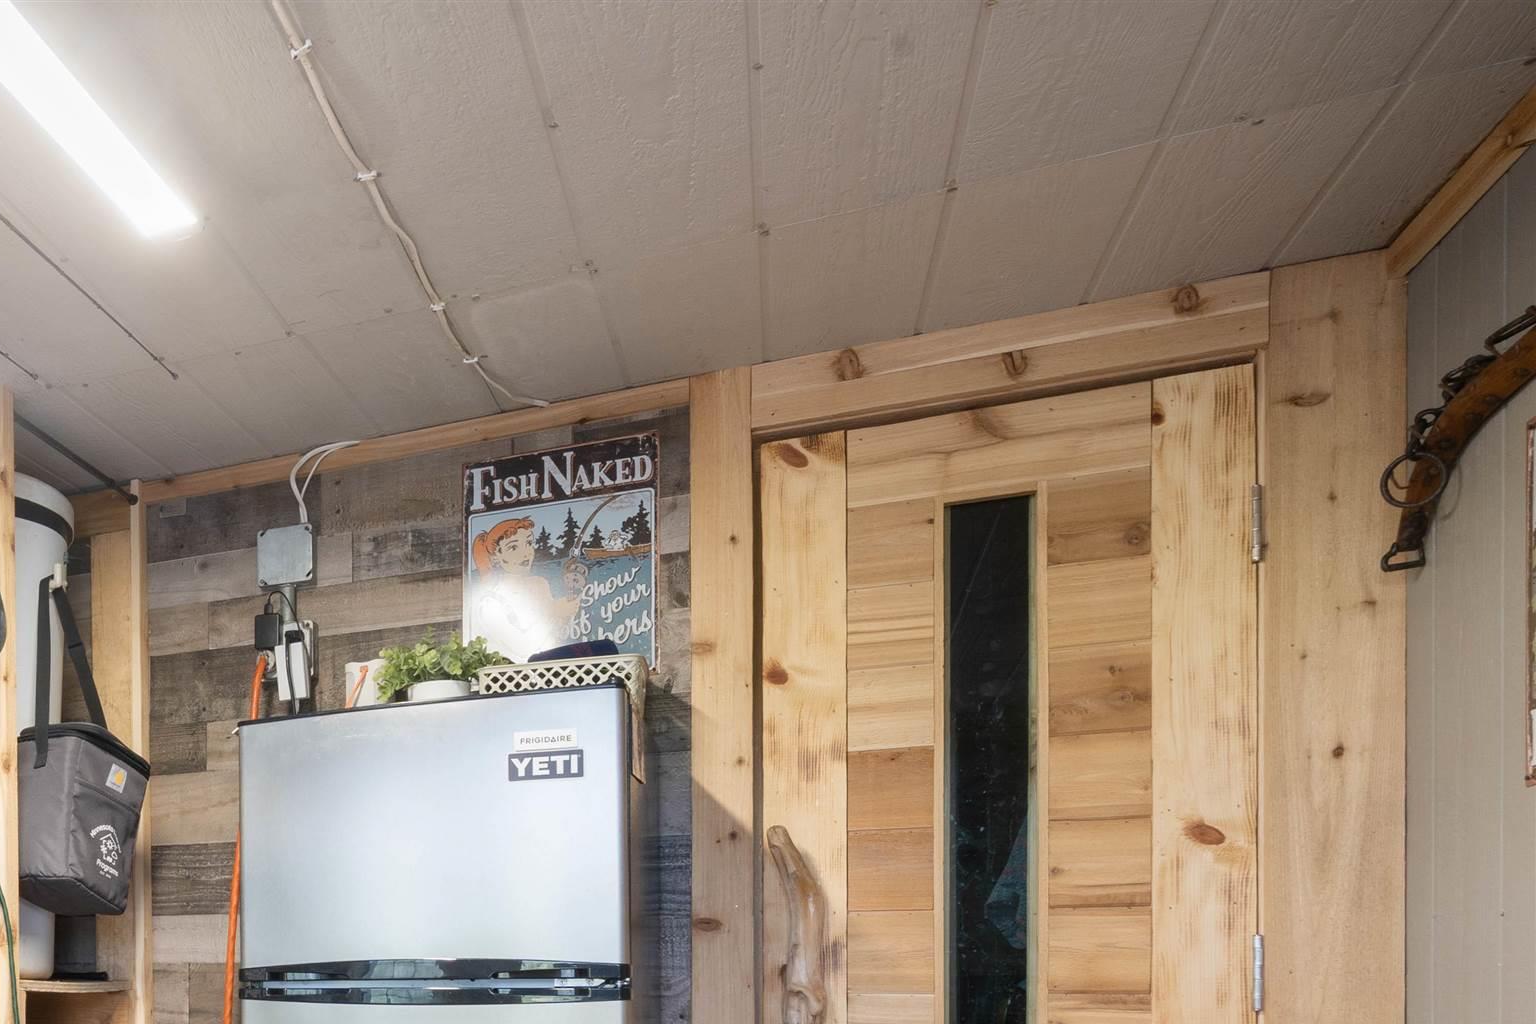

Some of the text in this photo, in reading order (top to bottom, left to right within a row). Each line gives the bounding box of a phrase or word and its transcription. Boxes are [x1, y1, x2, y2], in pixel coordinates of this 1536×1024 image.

[581, 565, 641, 607] Show
[559, 583, 651, 642] off your
[520, 735, 572, 745] FRIGIDAIRE
[510, 754, 579, 777] YETI
